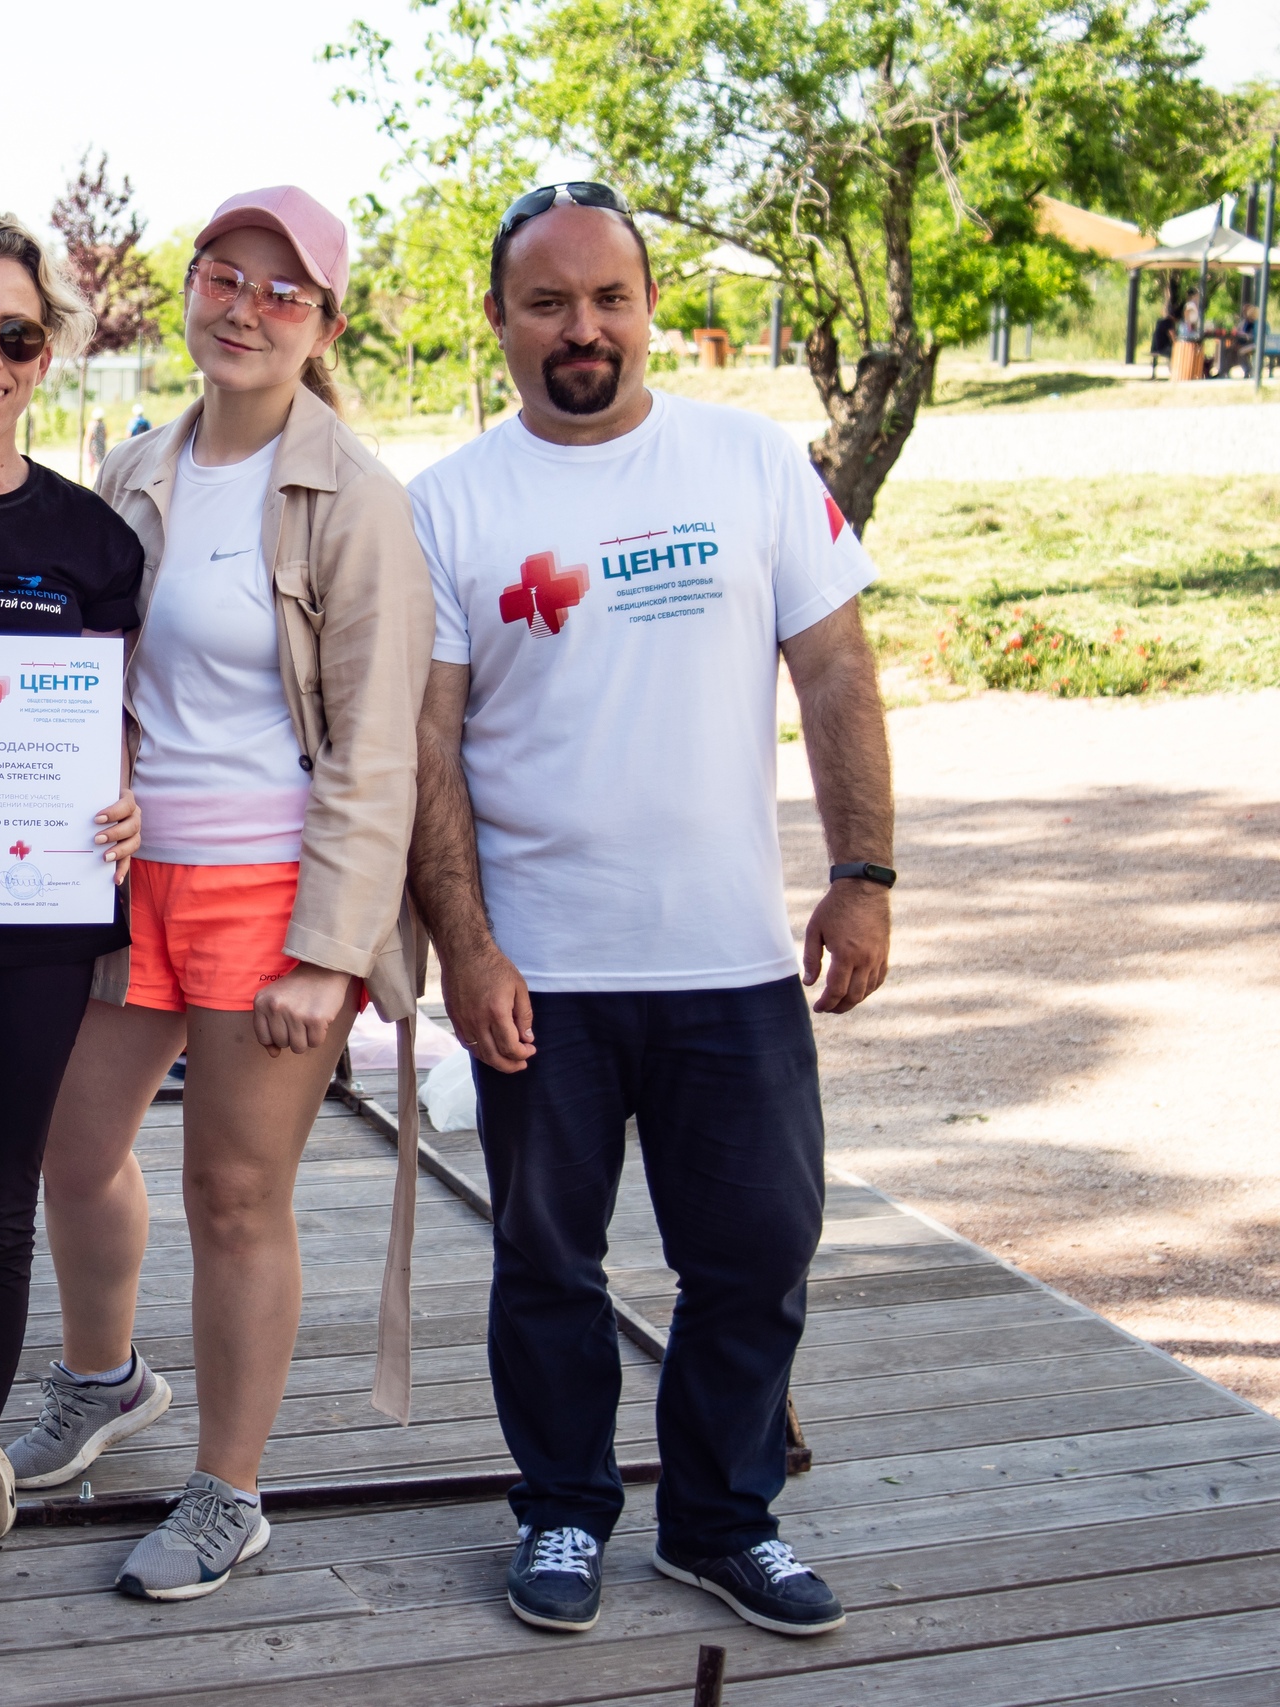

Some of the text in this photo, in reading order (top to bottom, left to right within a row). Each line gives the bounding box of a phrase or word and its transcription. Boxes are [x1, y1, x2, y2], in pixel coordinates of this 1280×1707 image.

[673, 522, 715, 534] МИАЦ
[602, 542, 718, 581] ЦЕНТР
[617, 578, 713, 597] ОБЩЕСТВЕННОГО ЗДОРОВЬЯ
[20, 601, 33, 610] со
[35, 602, 62, 615] мной
[615, 596, 667, 612] МЕДИЦИНСКОЙ
[669, 592, 723, 603] ПРОФИЛАКТИКИ
[630, 608, 704, 623] ГОРОДА СЕВАСТОПОЛЯ
[70, 661, 100, 670] МИАЦ
[20, 674, 99, 693] ЦЕНТР
[6, 773, 61, 781] STRETCHING
